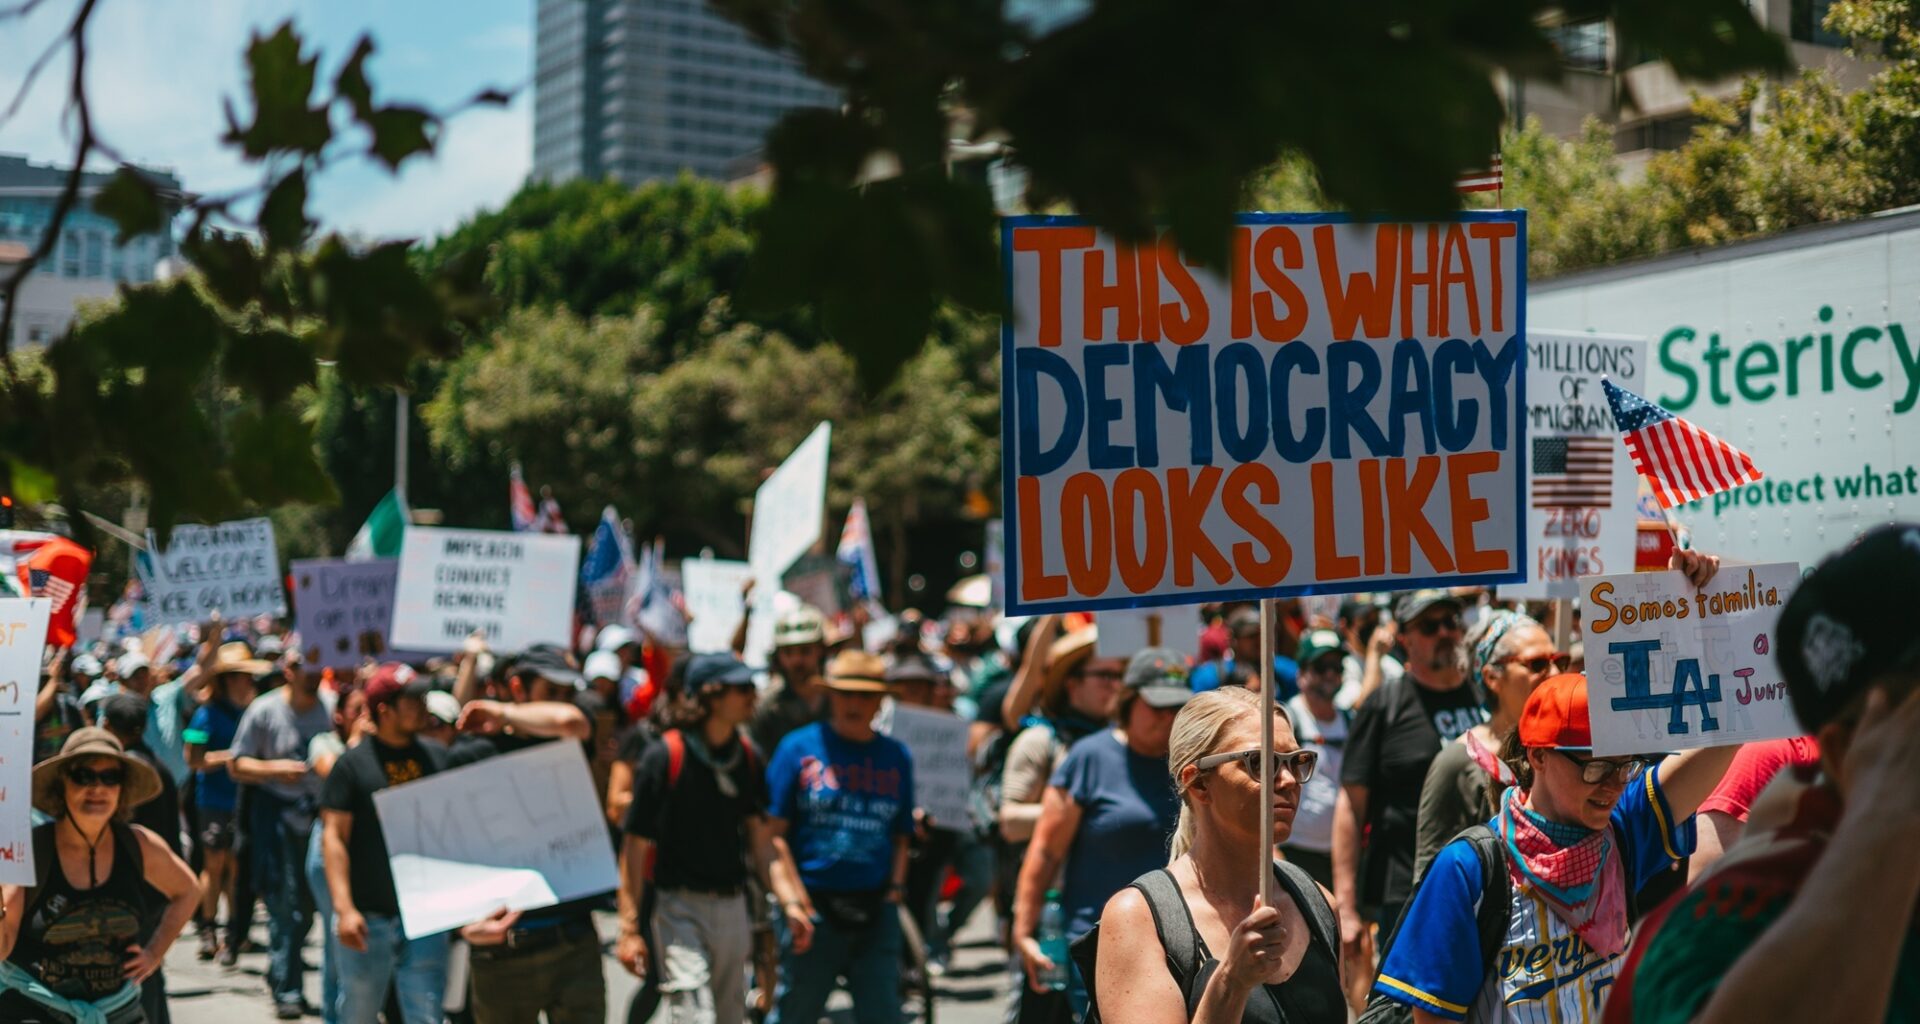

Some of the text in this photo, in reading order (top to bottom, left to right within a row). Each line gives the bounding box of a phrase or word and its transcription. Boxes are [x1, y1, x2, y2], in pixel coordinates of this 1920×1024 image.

[1013, 222, 1516, 346] THIS IS WHAT
[1527, 340, 1635, 379] MILLIONS
[1658, 305, 1920, 414] Stericy
[1016, 334, 1517, 476] DEMOCRACY
[1560, 375, 1589, 403] OF
[1713, 463, 1919, 517] protect what
[1018, 451, 1509, 600] LOOKS LIKE
[1544, 506, 1601, 538] ZERO
[1537, 546, 1604, 581] KINGS
[197, 585, 227, 612] GO
[230, 579, 283, 608] HOME
[434, 591, 506, 611] REMOVE
[1591, 582, 1690, 633] Somos
[1753, 633, 1769, 656] a
[1609, 639, 1722, 734] LA
[1500, 932, 1588, 979] very
